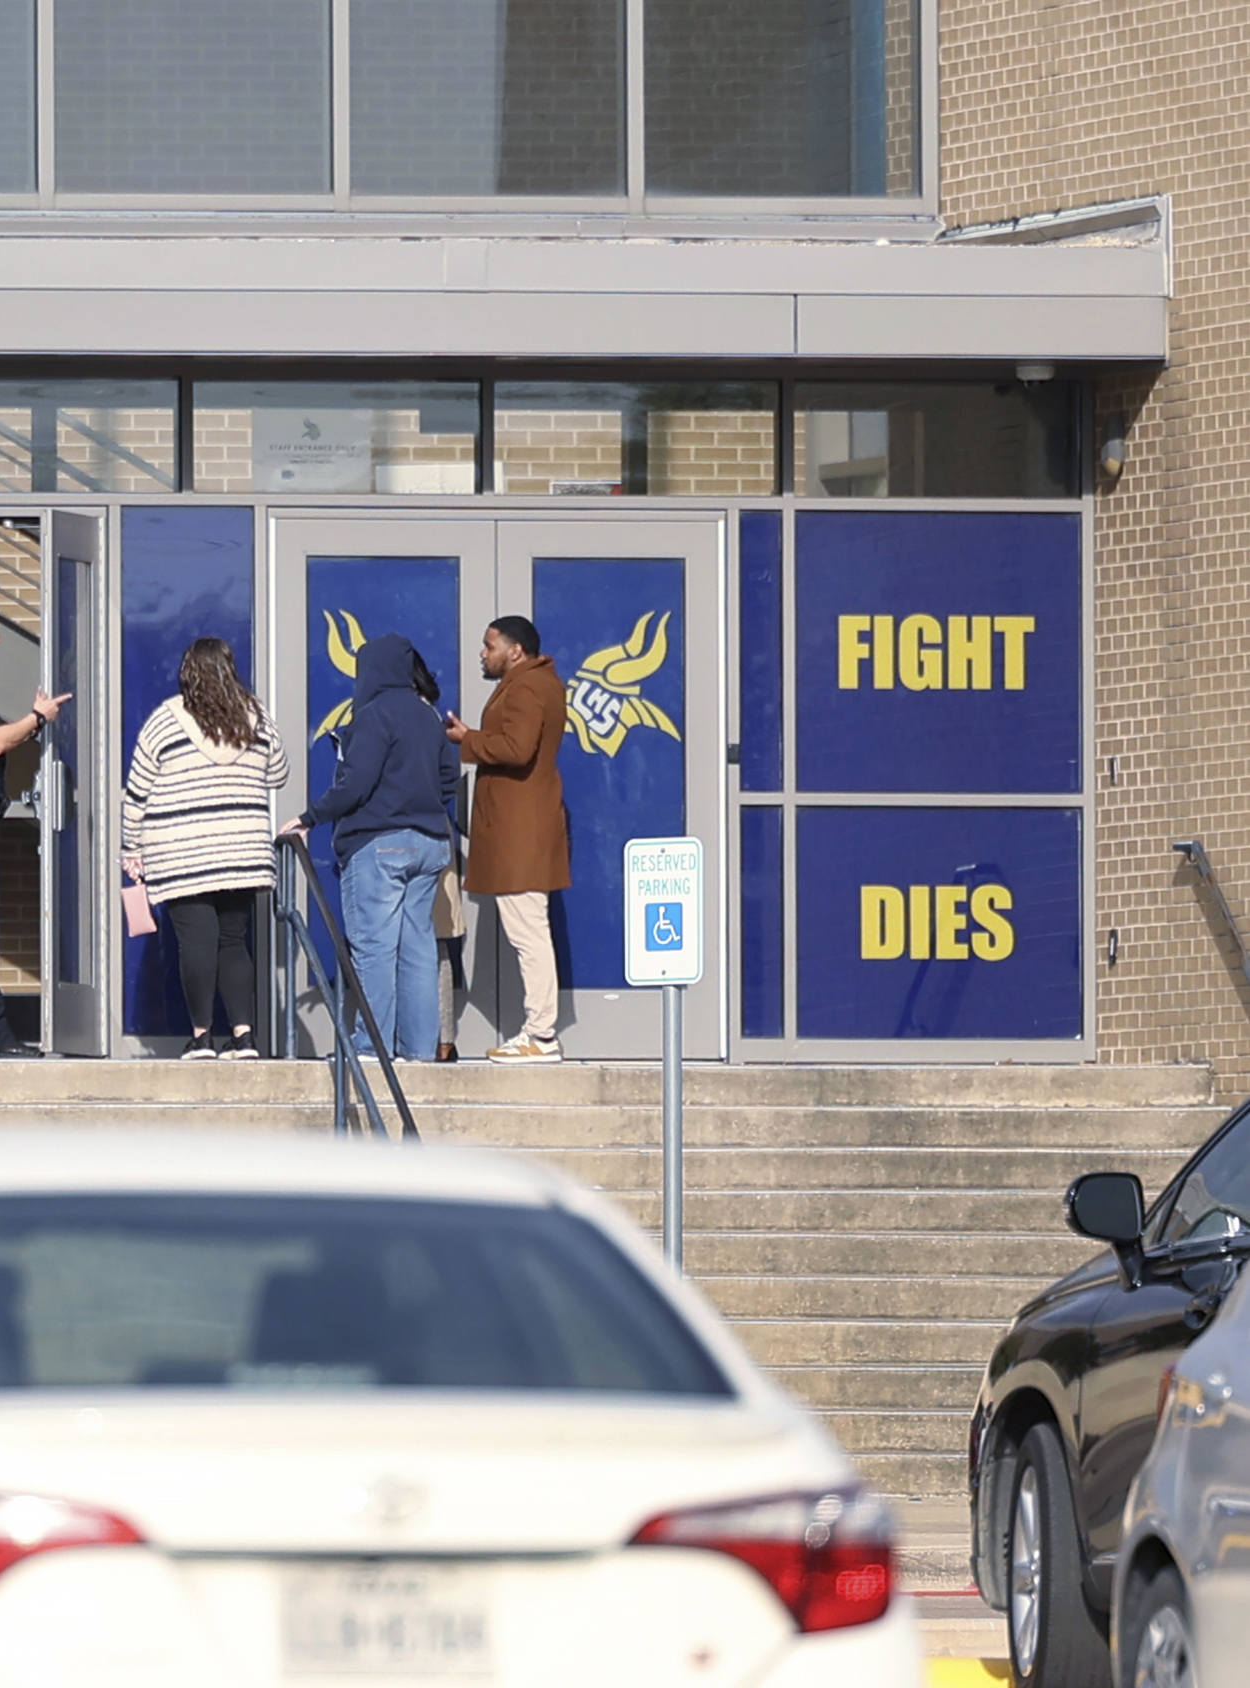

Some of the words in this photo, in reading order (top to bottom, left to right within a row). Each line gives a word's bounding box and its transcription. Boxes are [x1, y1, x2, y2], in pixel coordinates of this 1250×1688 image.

[269, 444, 291, 452] STAFF
[293, 444, 332, 452] ENTRANCE
[837, 613, 1036, 691] FIGHT
[633, 854, 696, 872] RESERVED
[638, 878, 690, 895] PARKING
[860, 884, 1015, 962] DIES
